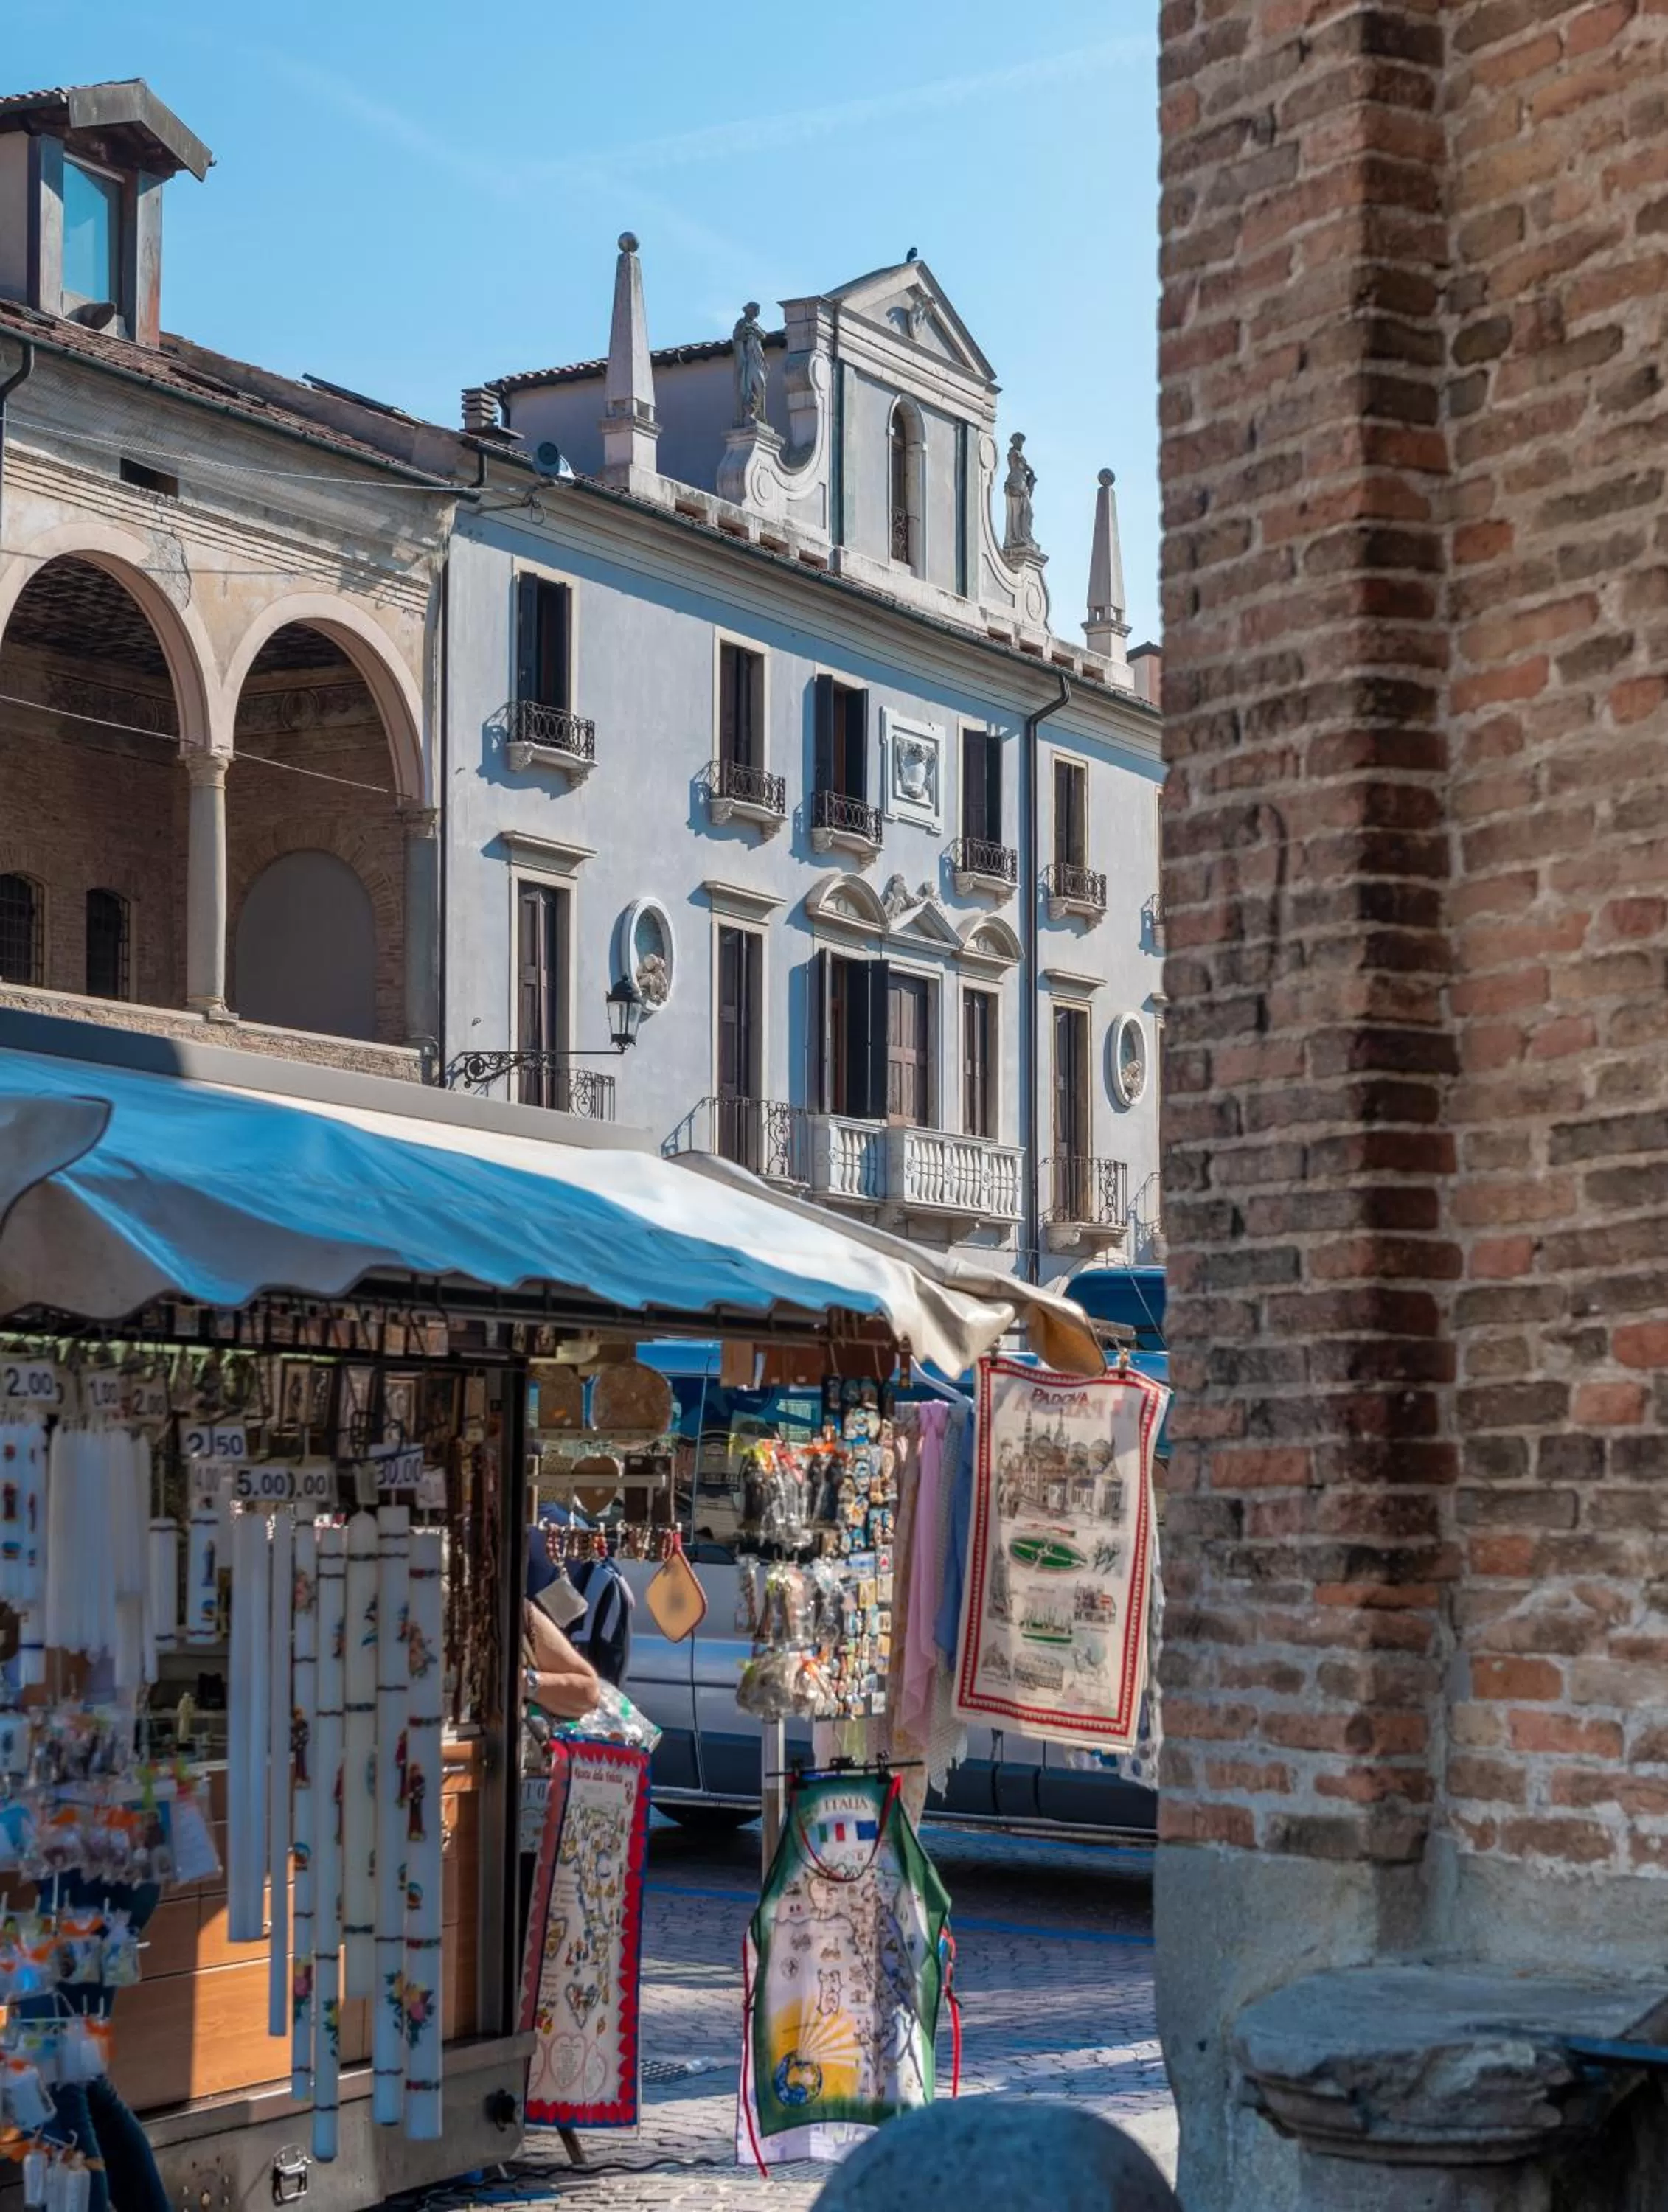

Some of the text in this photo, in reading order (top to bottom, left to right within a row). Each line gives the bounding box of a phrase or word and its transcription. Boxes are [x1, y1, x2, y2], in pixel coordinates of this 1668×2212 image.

[4, 1367, 53, 1397] 2.00
[1030, 1387, 1090, 1406] PADOVA
[187, 1432, 244, 1457] 250
[237, 1470, 286, 1497] 5.00
[824, 1797, 869, 1811] ITALIA
